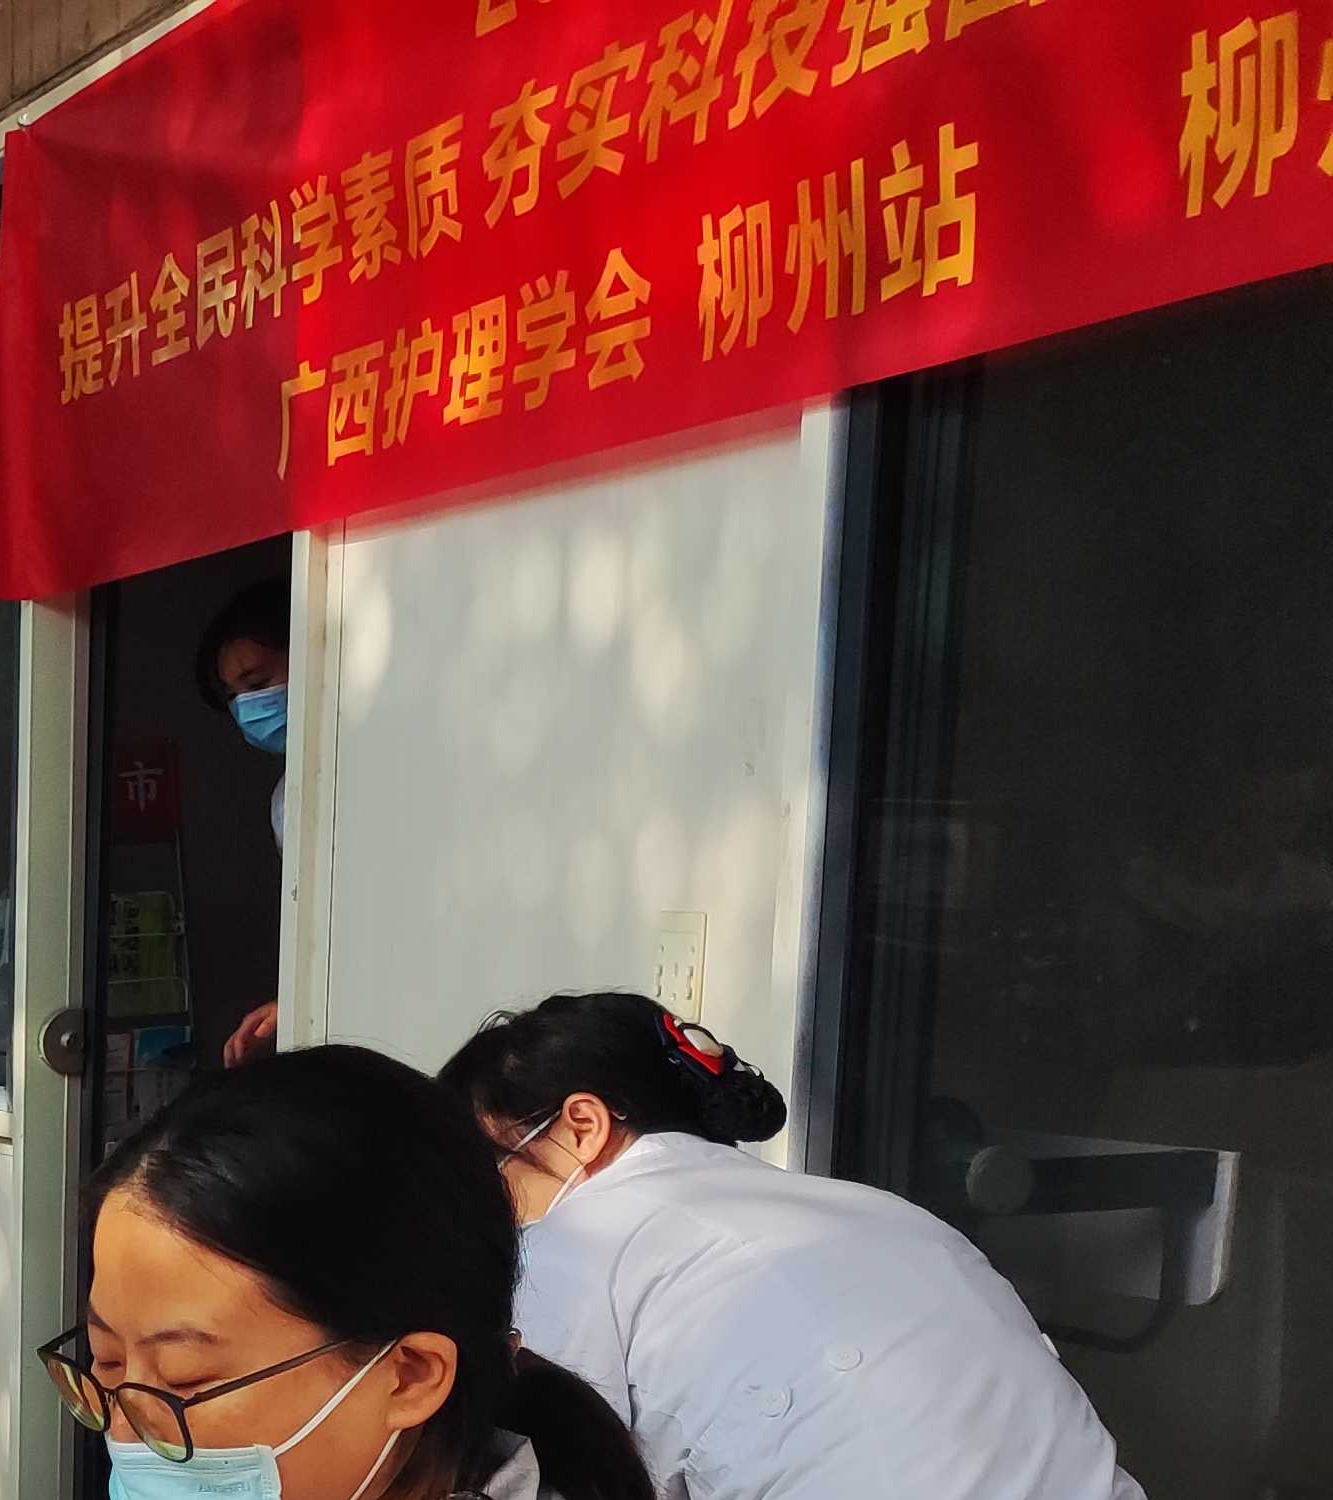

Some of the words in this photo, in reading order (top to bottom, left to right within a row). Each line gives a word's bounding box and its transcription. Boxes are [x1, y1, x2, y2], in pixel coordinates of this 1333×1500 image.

[56, 112, 465, 406] 提升全民科学素质
[275, 247, 653, 481] 广西护理学会
[696, 122, 982, 363] 柳州站
[1178, 11, 1333, 219] 柳
[119, 761, 165, 812] 市
